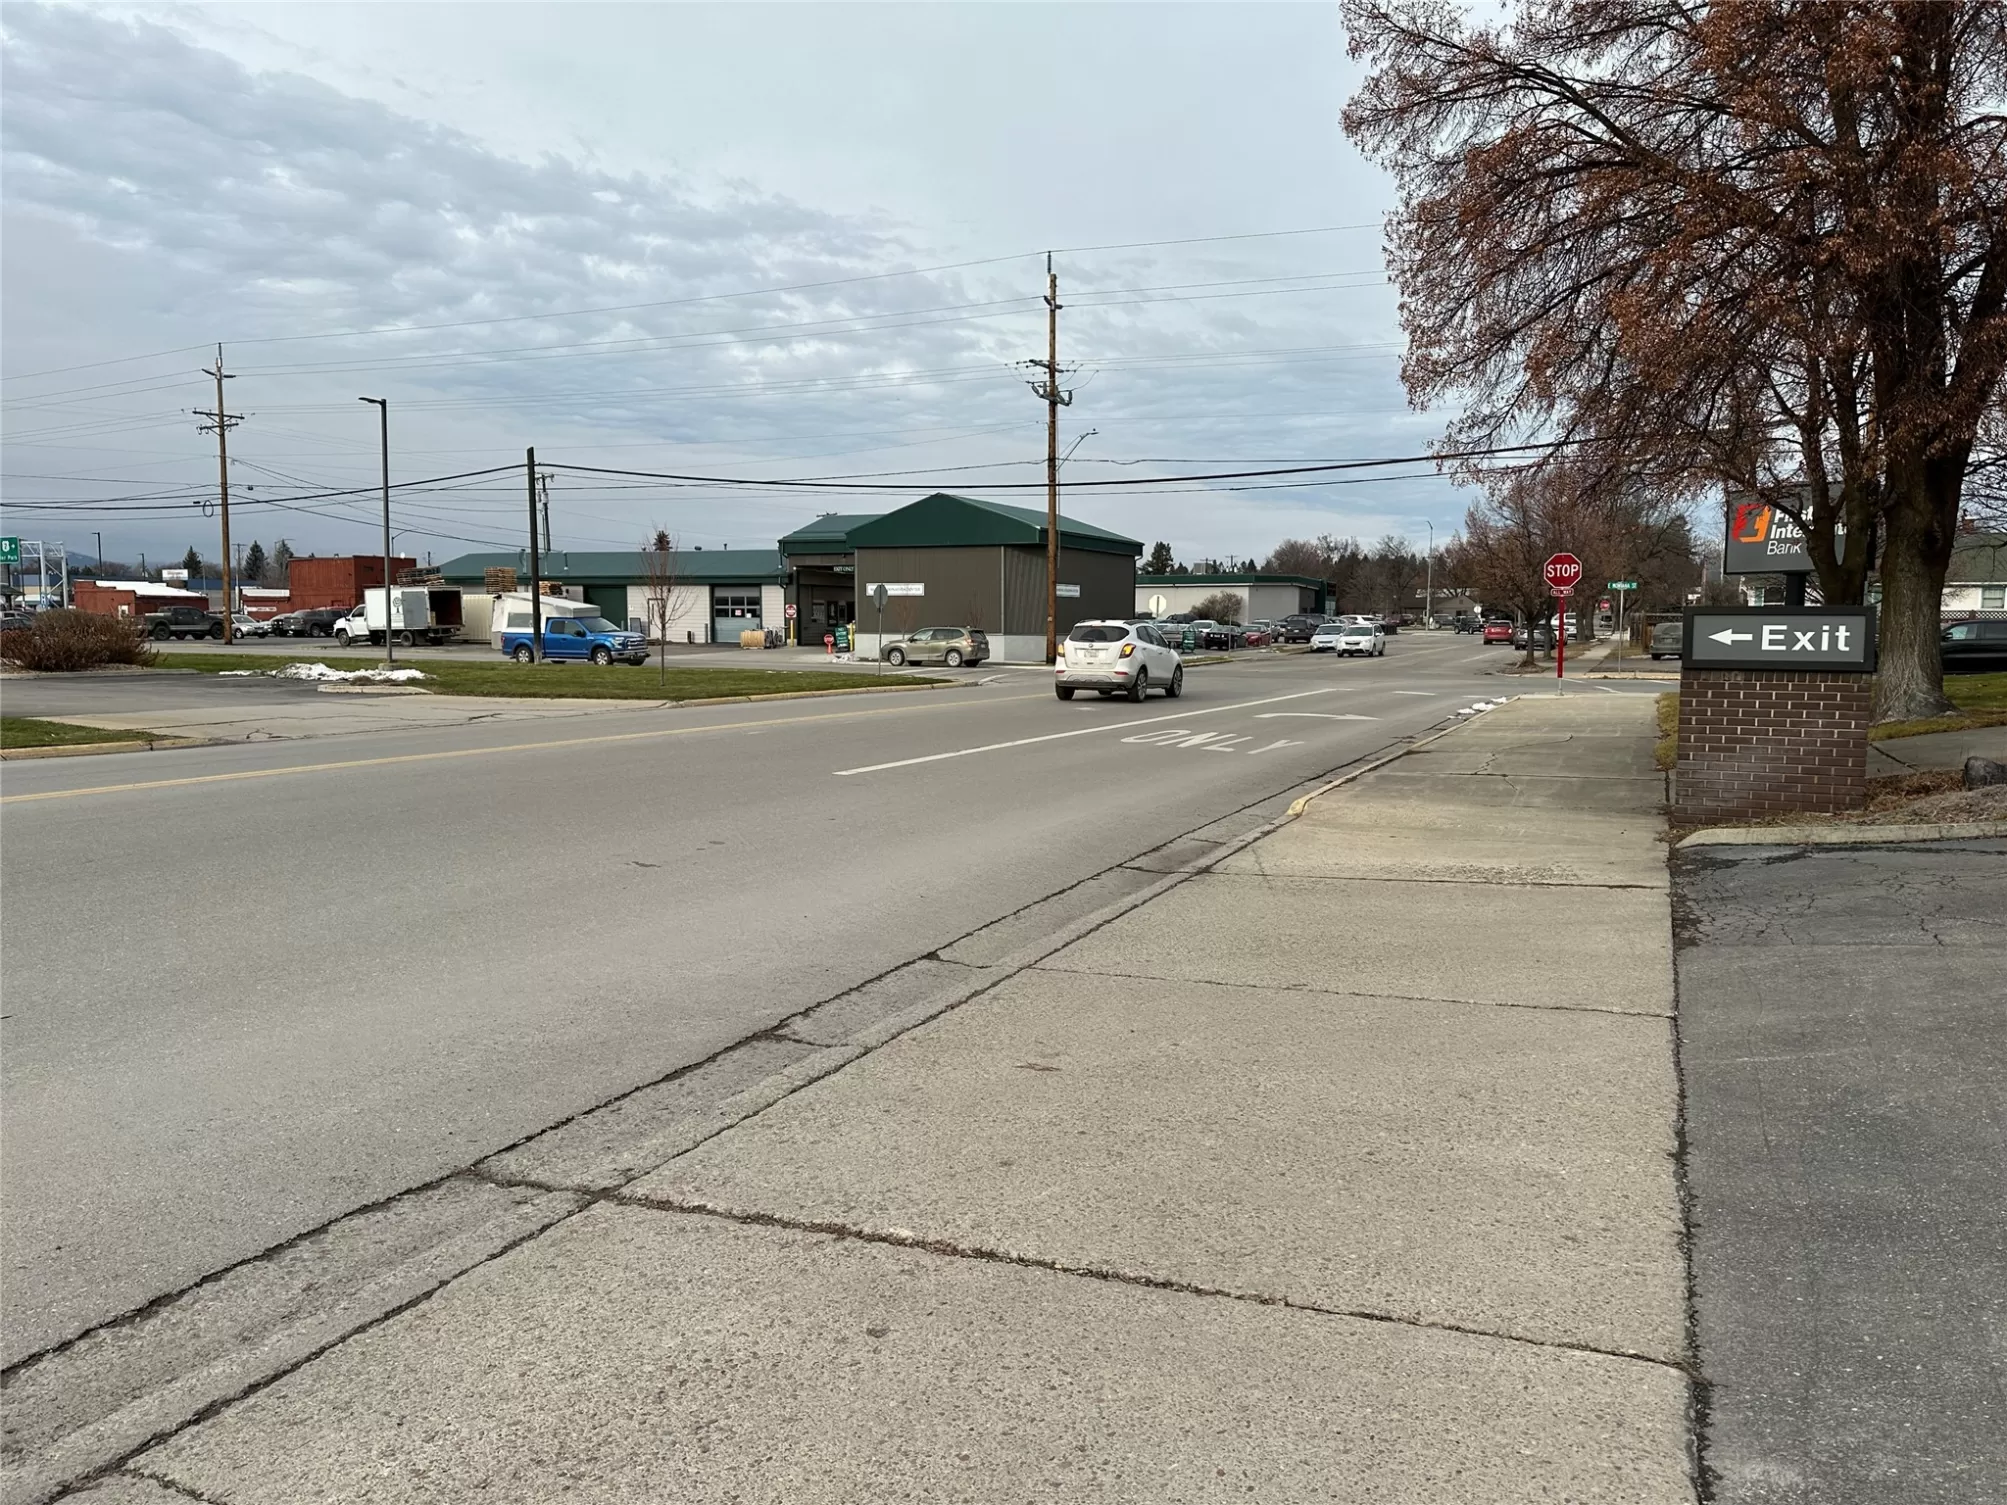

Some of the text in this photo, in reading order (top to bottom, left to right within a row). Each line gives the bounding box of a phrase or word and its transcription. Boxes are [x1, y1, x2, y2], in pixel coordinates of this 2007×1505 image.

[1767, 540, 1802, 555] Bank
[1547, 564, 1579, 577] STOP
[1761, 624, 1850, 651] Exit
[1120, 730, 1305, 754] ONLY
